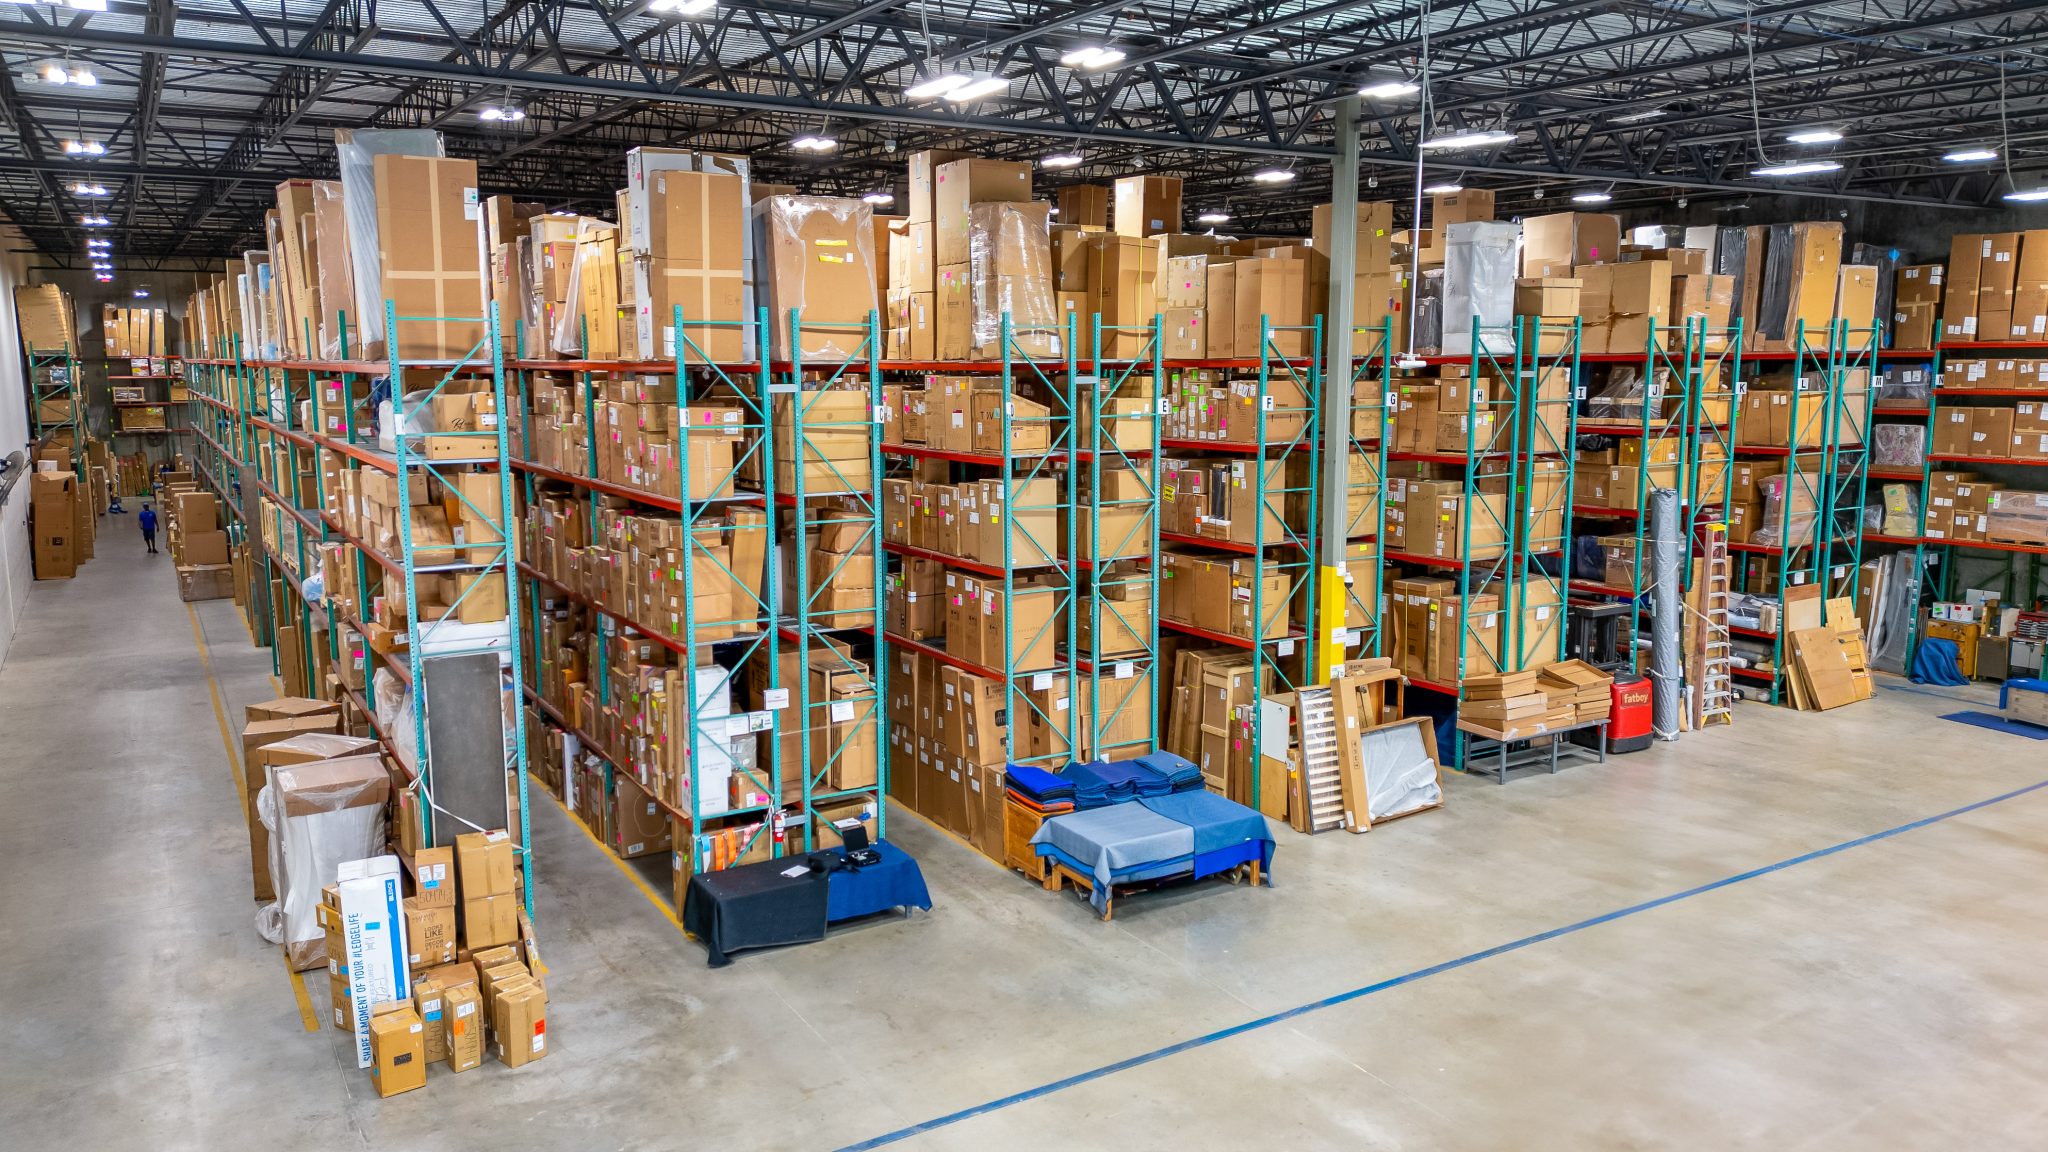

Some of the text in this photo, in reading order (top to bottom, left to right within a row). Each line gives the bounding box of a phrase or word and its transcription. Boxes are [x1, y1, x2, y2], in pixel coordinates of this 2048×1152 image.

[1801, 379, 1807, 388] L
[1876, 377, 1882, 386] M
[1578, 388, 1584, 398] I
[1652, 385, 1658, 396] J
[1739, 383, 1745, 393] K
[1390, 393, 1396, 405] G
[1477, 390, 1483, 401] H
[1162, 400, 1167, 412] E
[1266, 397, 1272, 408] F
[879, 407, 884, 421] C
[348, 912, 363, 958] #LEDGELIFE
[424, 929, 443, 939] LIKE
[353, 961, 365, 981] YOUR
[356, 984, 365, 993] OF
[357, 996, 370, 1030] MOMENT
